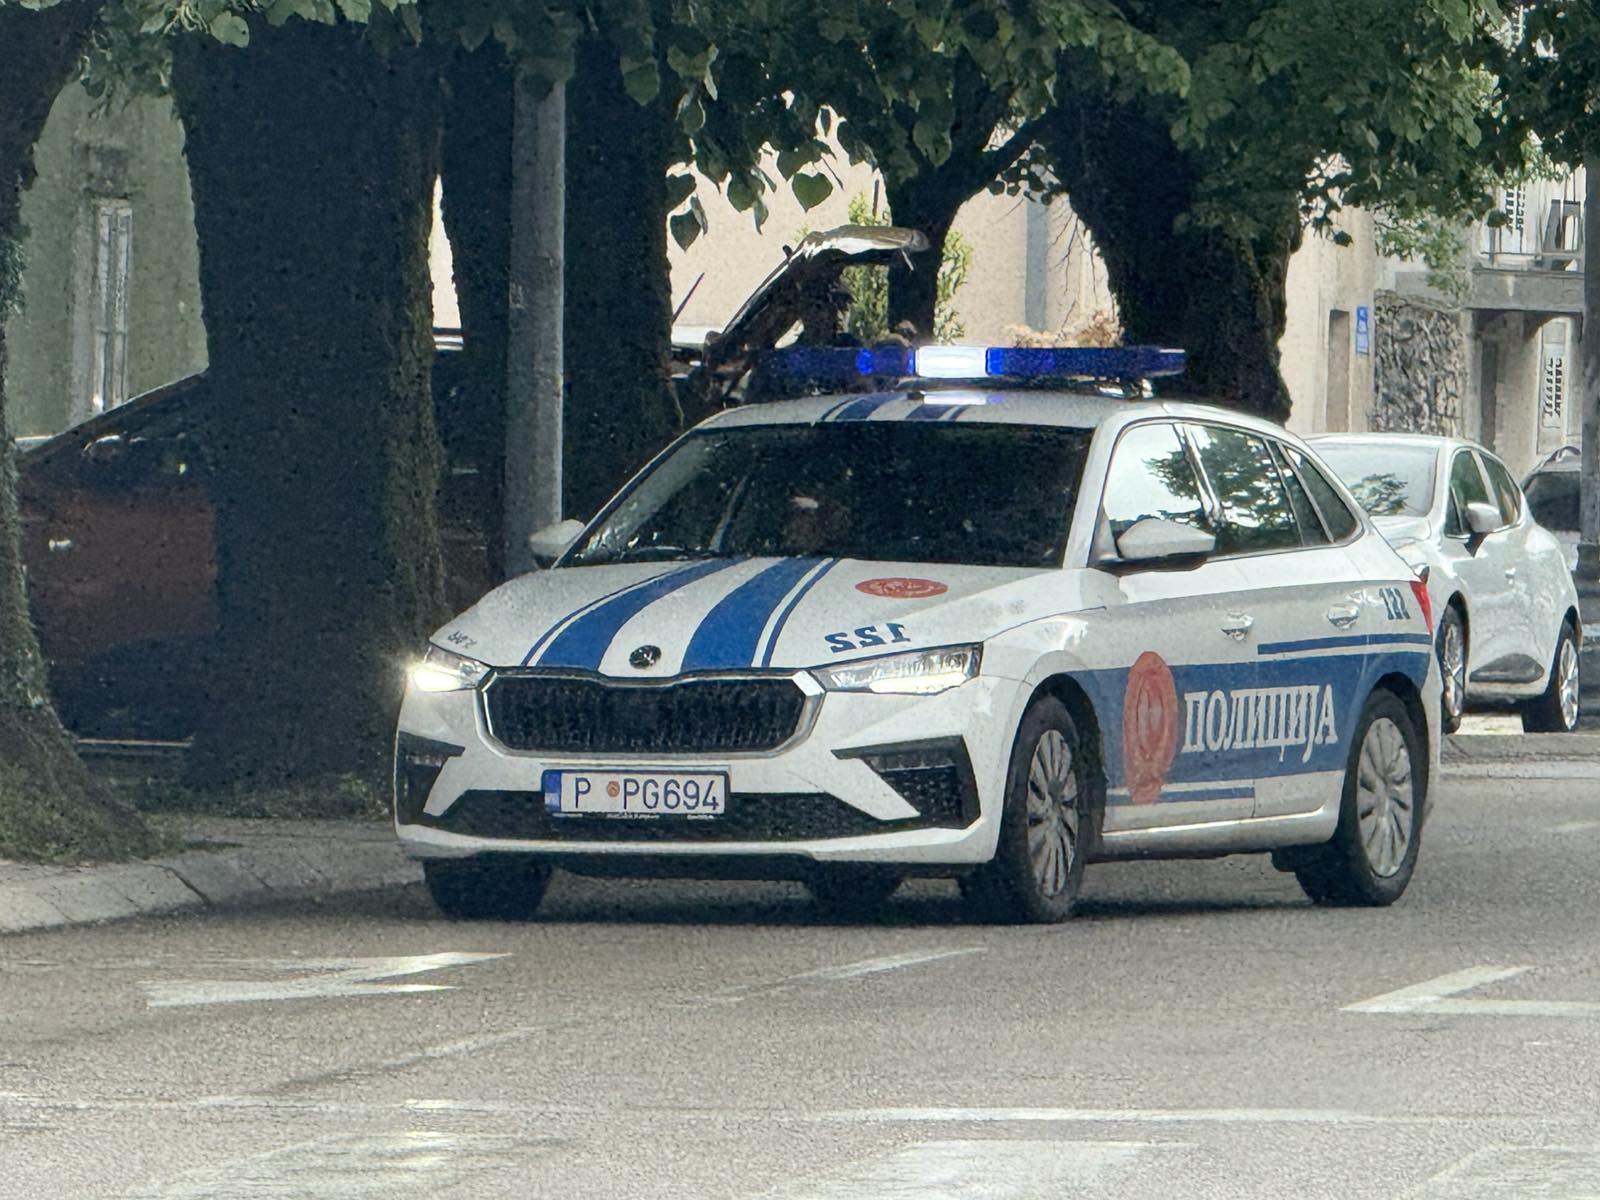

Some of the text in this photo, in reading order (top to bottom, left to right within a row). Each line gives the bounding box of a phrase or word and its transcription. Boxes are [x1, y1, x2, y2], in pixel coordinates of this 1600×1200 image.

[1181, 684, 1338, 763] ПОЛИЦИЈА
[575, 777, 719, 810] P PG694
